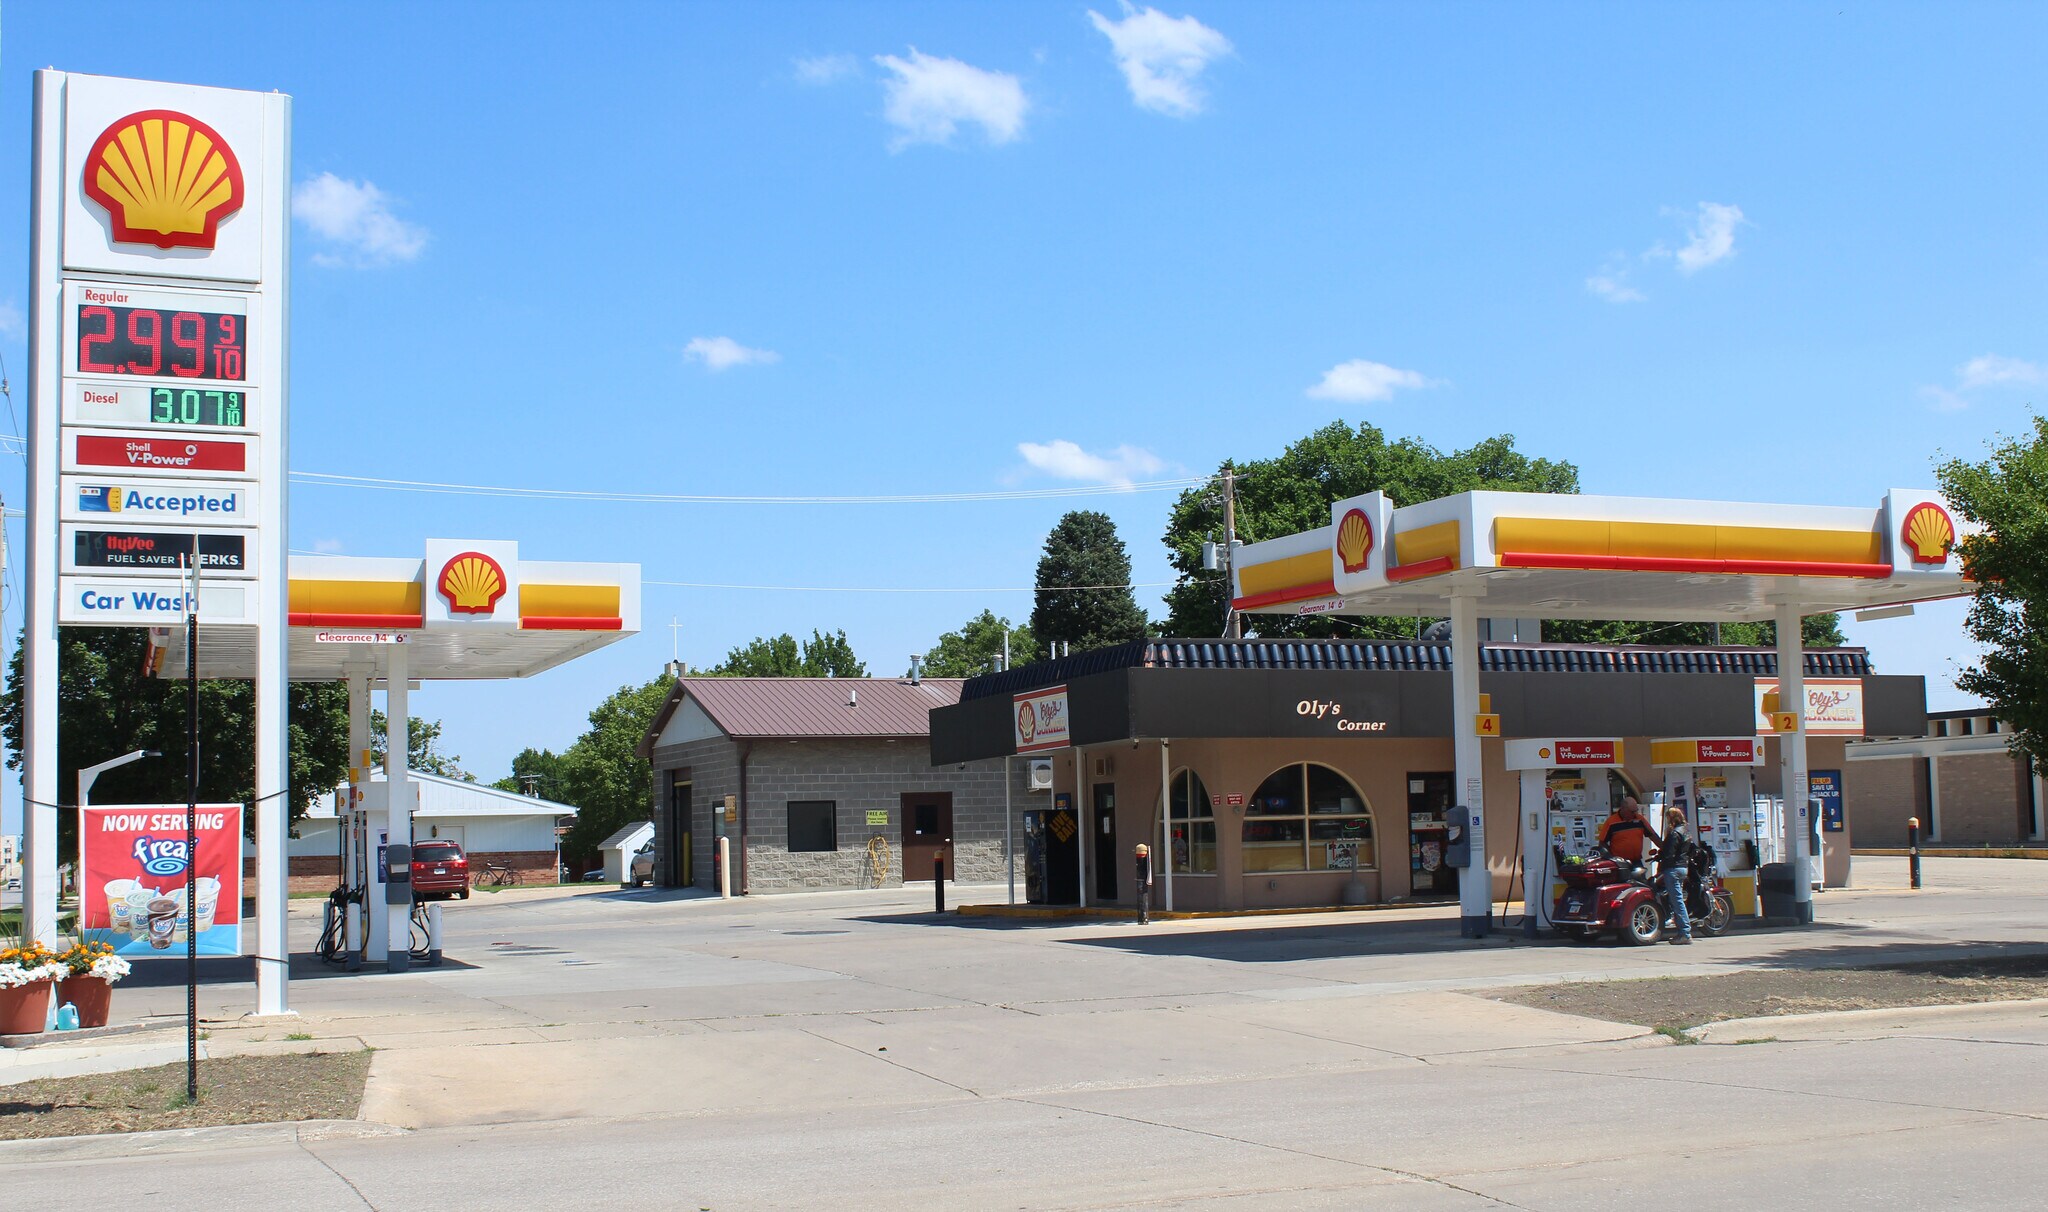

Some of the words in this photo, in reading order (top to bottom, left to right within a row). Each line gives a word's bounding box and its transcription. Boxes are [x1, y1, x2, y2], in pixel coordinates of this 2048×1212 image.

[85, 289, 129, 304] Regular
[80, 305, 206, 378] 2.99
[83, 391, 119, 404] Diesel
[154, 388, 224, 426] 3.07
[126, 442, 151, 452] Shell
[126, 452, 192, 466] V-Power
[125, 491, 236, 515] Accepted
[107, 554, 136, 563] FUEL
[139, 555, 175, 564] SAVER
[81, 591, 125, 610] Car
[1300, 604, 1326, 615] Clearance
[318, 632, 373, 642] Clearance
[1296, 699, 1341, 720] Oly's
[1336, 719, 1387, 731] Corner
[1482, 718, 1492, 732] 4
[1783, 716, 1792, 730] 2
[102, 814, 148, 832] NOW
